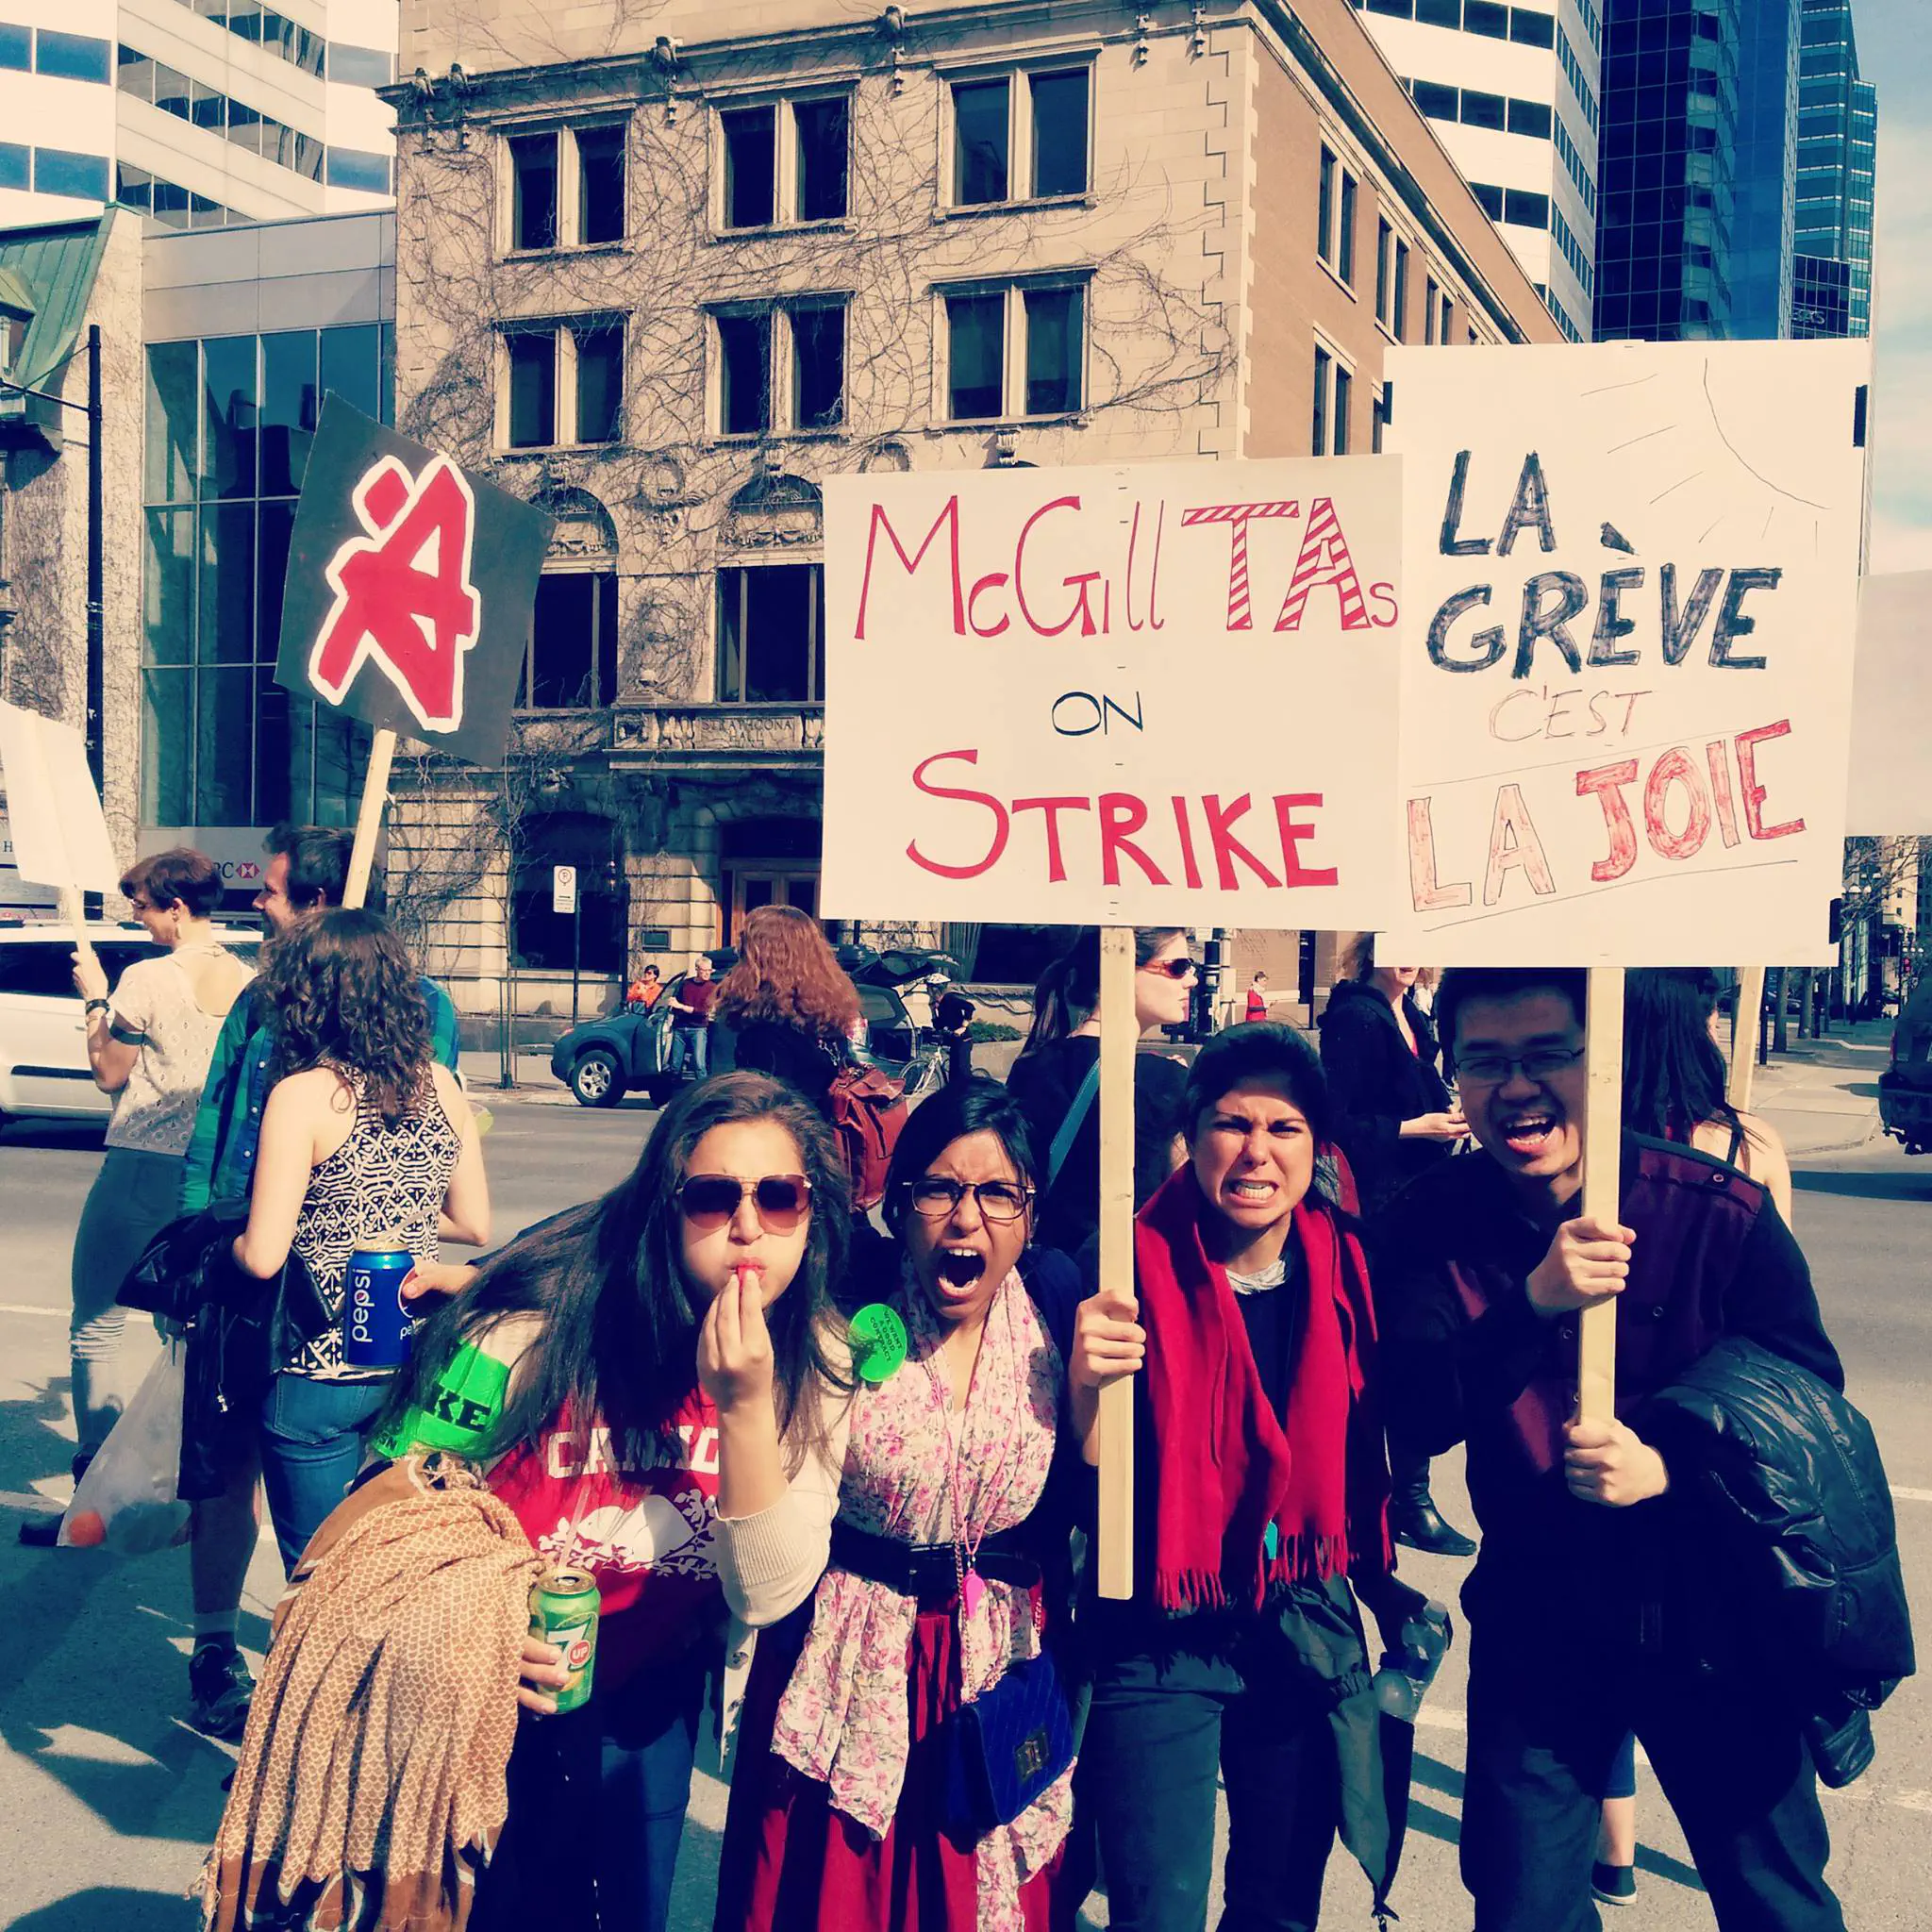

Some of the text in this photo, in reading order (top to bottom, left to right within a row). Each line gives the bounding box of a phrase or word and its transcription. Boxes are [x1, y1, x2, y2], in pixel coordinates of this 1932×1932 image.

[1440, 449, 1557, 557] LA
[854, 494, 1399, 640] McGill TAs
[1425, 521, 1783, 680] GRÈVE
[701, 718, 793, 731] STRATHCONA
[729, 730, 764, 745] HALL
[1051, 691, 1144, 736] ON
[1488, 682, 1652, 742] C'EST
[906, 748, 1338, 891] STRIKE
[1406, 720, 1807, 912] LA JOIE
[352, 1268, 375, 1342] pepsi
